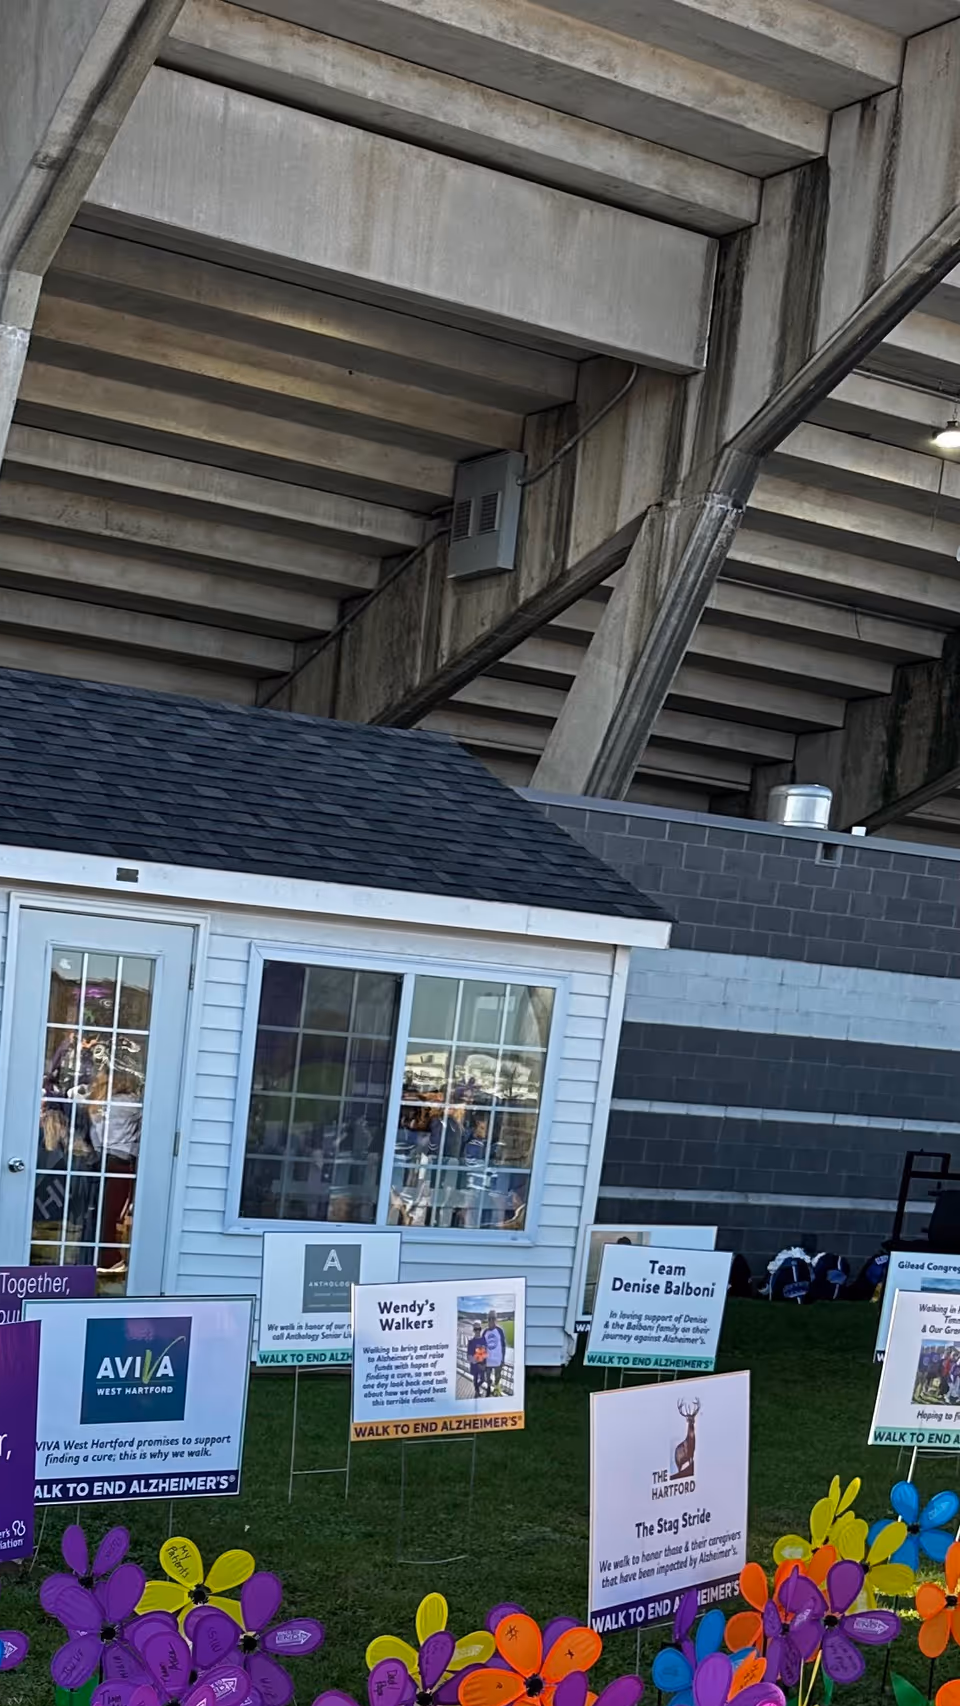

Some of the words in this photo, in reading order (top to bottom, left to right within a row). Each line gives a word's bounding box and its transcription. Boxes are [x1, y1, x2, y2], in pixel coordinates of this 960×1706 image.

[323, 1249, 342, 1271] A
[649, 1260, 686, 1276] Team
[898, 1261, 925, 1271] Gilead
[0, 1272, 70, 1298] Together,
[611, 1277, 661, 1294] Denise
[664, 1281, 716, 1297] Balboni
[378, 1299, 435, 1317] Wendy's
[919, 1304, 948, 1315] Walking
[949, 1305, 956, 1314] in
[380, 1318, 434, 1331] Walkers
[619, 1311, 643, 1322] loving
[644, 1314, 673, 1323] support
[684, 1315, 708, 1324] Denise
[611, 1322, 624, 1330] the
[625, 1322, 655, 1332] Balboni
[655, 1325, 679, 1334] family
[692, 1326, 710, 1334] their
[928, 1325, 943, 1334] Our
[601, 1331, 632, 1342] journey
[634, 1333, 662, 1343] against
[662, 1335, 706, 1345] Alzheimer's.
[96, 1340, 184, 1384] AVIVA
[259, 1354, 288, 1364] WALK
[290, 1354, 304, 1362] TO
[306, 1353, 327, 1362] END
[587, 1355, 614, 1364] WALK
[617, 1356, 629, 1365] TO
[632, 1357, 652, 1366] END
[125, 1386, 174, 1395] HARTFORD
[917, 1410, 943, 1422] Hoping
[354, 1425, 390, 1437] WALK
[393, 1424, 410, 1434] TO
[413, 1422, 438, 1433] END
[874, 1430, 908, 1442] WALK
[909, 1432, 925, 1443] TO
[928, 1432, 951, 1445] END
[36, 1441, 60, 1451] VIVA
[63, 1441, 88, 1450] West
[91, 1438, 135, 1449] Hartford
[136, 1436, 179, 1448] promises
[182, 1437, 192, 1445] to
[194, 1435, 231, 1446] support
[44, 1452, 80, 1466] finding
[119, 1451, 137, 1461] this
[140, 1450, 147, 1459] is
[149, 1449, 169, 1461] why
[172, 1450, 185, 1458] we
[187, 1448, 212, 1457] walk.
[652, 1469, 668, 1484] THE
[34, 1484, 62, 1498] ALK
[67, 1483, 89, 1496] TO
[93, 1481, 126, 1496] END
[651, 1480, 696, 1501] HARTFORD
[635, 1521, 655, 1539] The
[657, 1517, 679, 1535] Stag
[681, 1508, 711, 1529] Stride
[179, 1545, 191, 1561] My
[599, 1560, 612, 1574] We
[613, 1557, 631, 1569] walk
[632, 1555, 640, 1565] to
[641, 1550, 662, 1563] honor
[664, 1545, 683, 1558] those
[691, 1536, 707, 1551] their
[708, 1530, 742, 1545] caregivers
[166, 1546, 189, 1578] Patients
[601, 1576, 618, 1589] that
[619, 1572, 637, 1585] have
[638, 1568, 655, 1580] been
[656, 1558, 688, 1576] impacted
[689, 1555, 698, 1569] by
[698, 1546, 738, 1564] Alzheimer's.
[592, 1610, 626, 1633] WALK
[628, 1605, 645, 1625] TO
[647, 1599, 671, 1619] END
